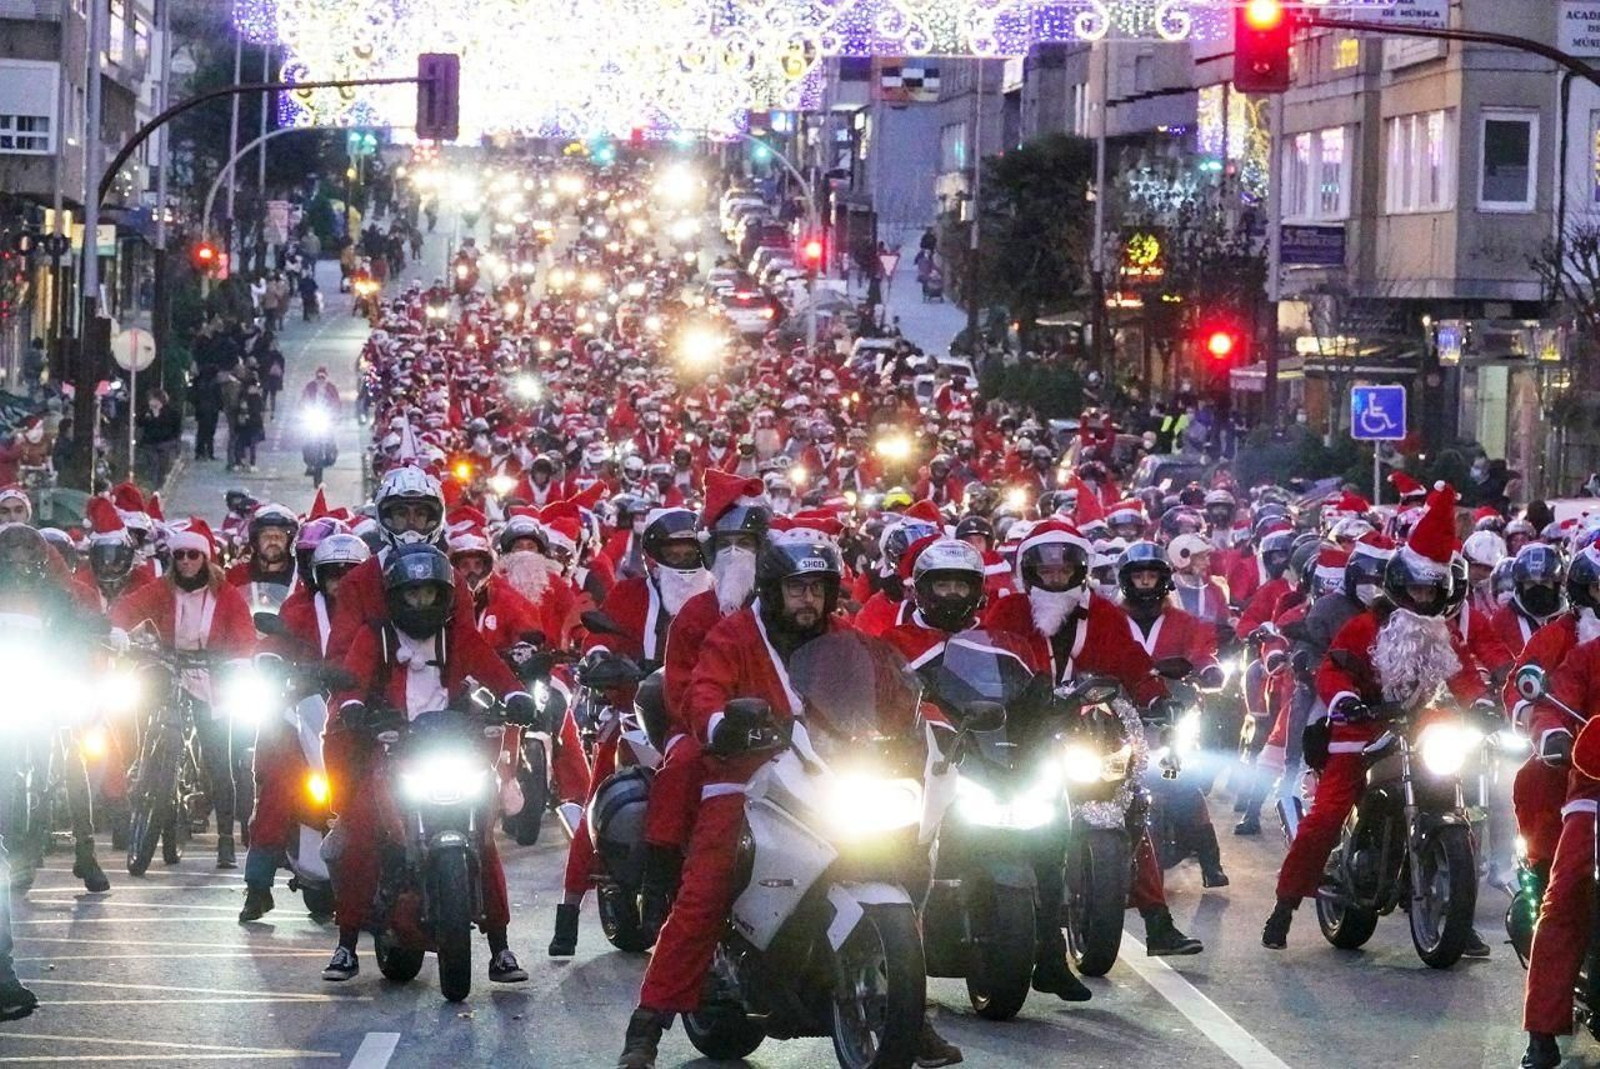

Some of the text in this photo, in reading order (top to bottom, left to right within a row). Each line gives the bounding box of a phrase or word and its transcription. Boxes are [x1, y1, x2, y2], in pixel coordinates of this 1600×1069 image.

[1382, 8, 1440, 18] DE MÚSICA
[802, 560, 825, 568] SHOEI
